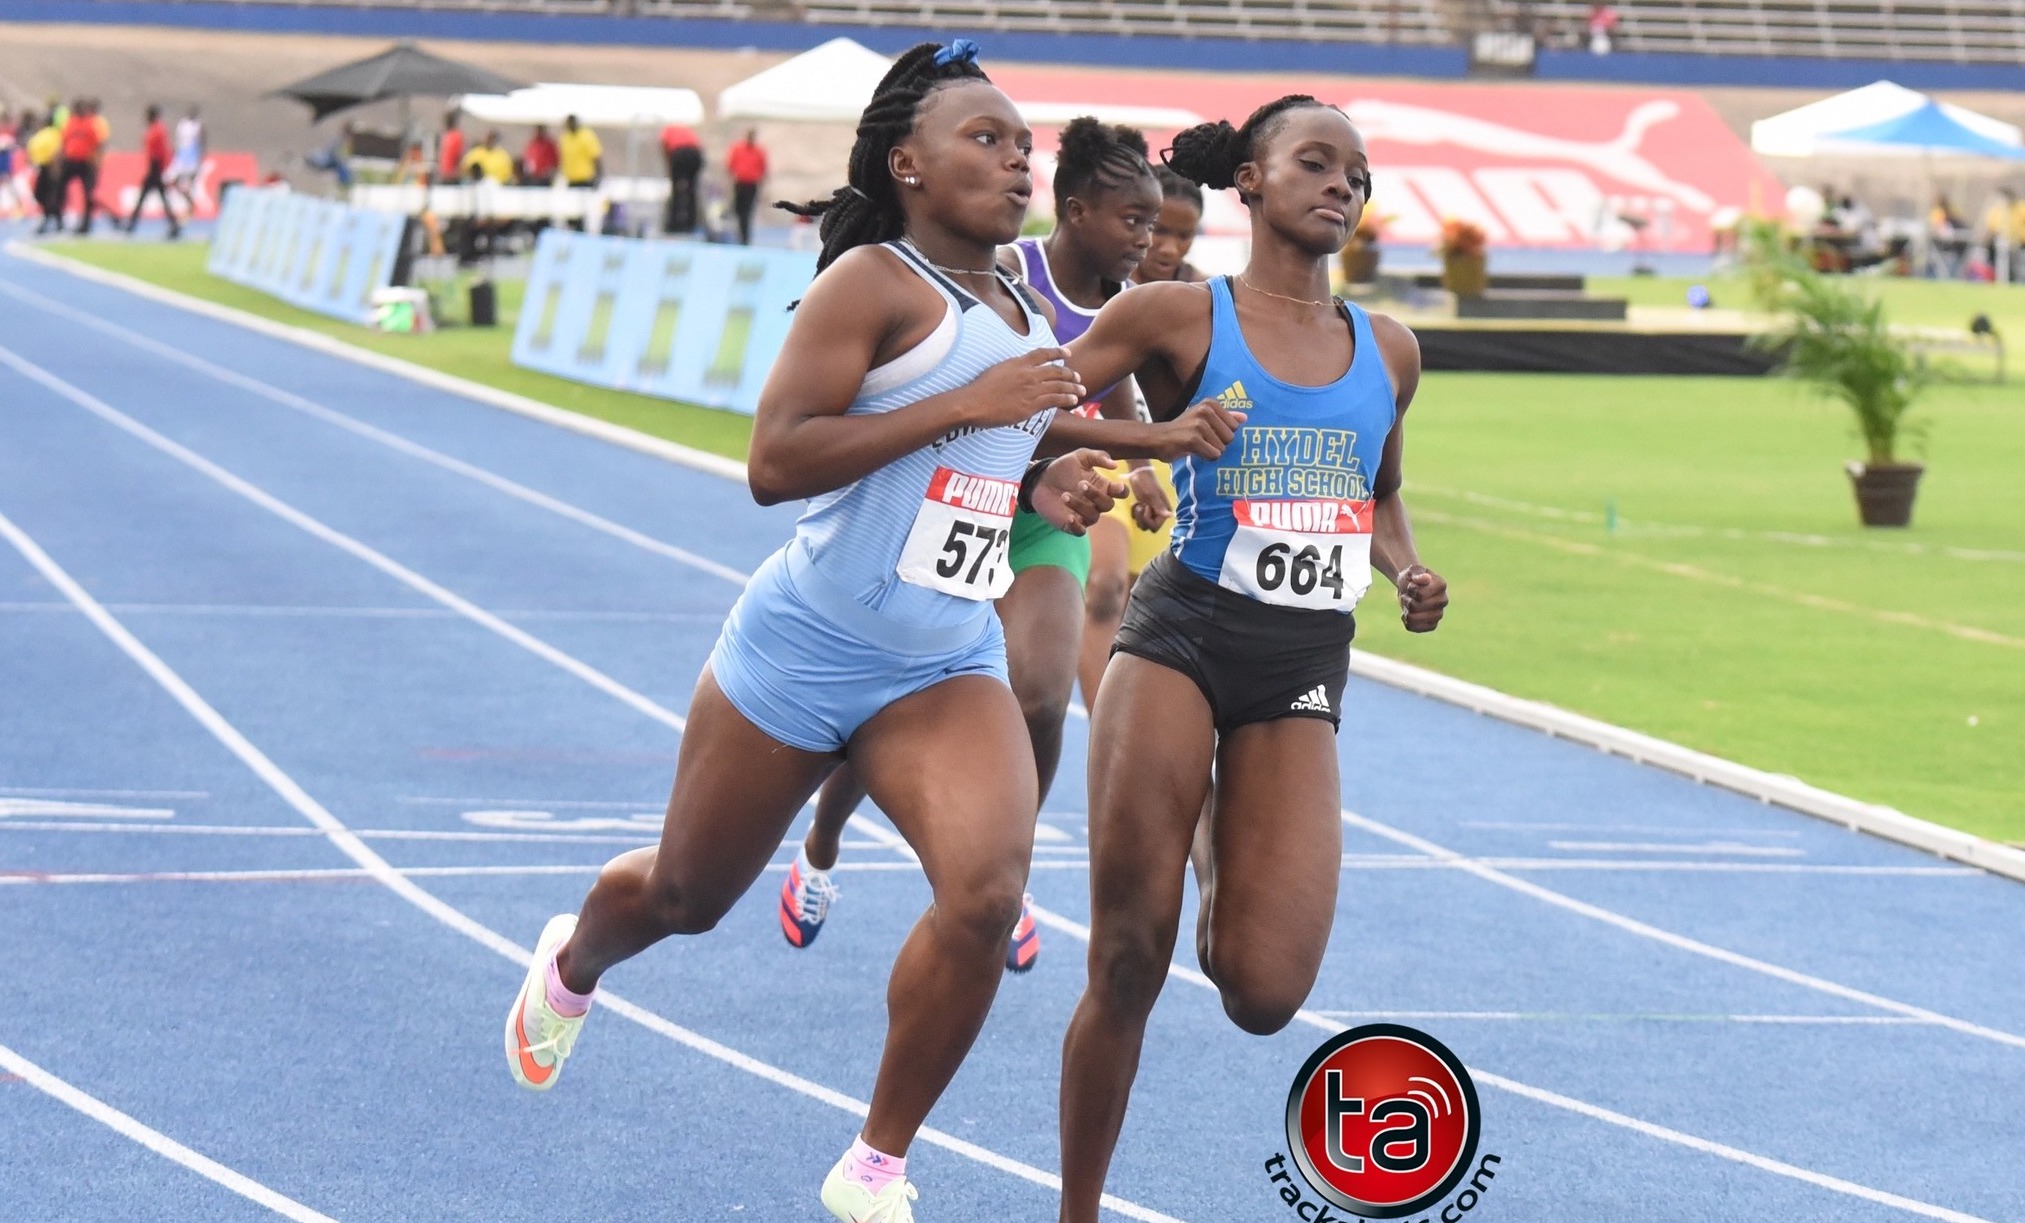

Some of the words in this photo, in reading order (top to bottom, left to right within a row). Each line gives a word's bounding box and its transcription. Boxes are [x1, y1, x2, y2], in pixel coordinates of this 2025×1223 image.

[1241, 427, 1360, 471] HYDEL
[942, 472, 1014, 516] PUMA
[1216, 467, 1283, 496] HIGH
[1287, 468, 1371, 501] SCHOOL
[1251, 502, 1340, 534] PUMA
[1256, 541, 1344, 600] 664
